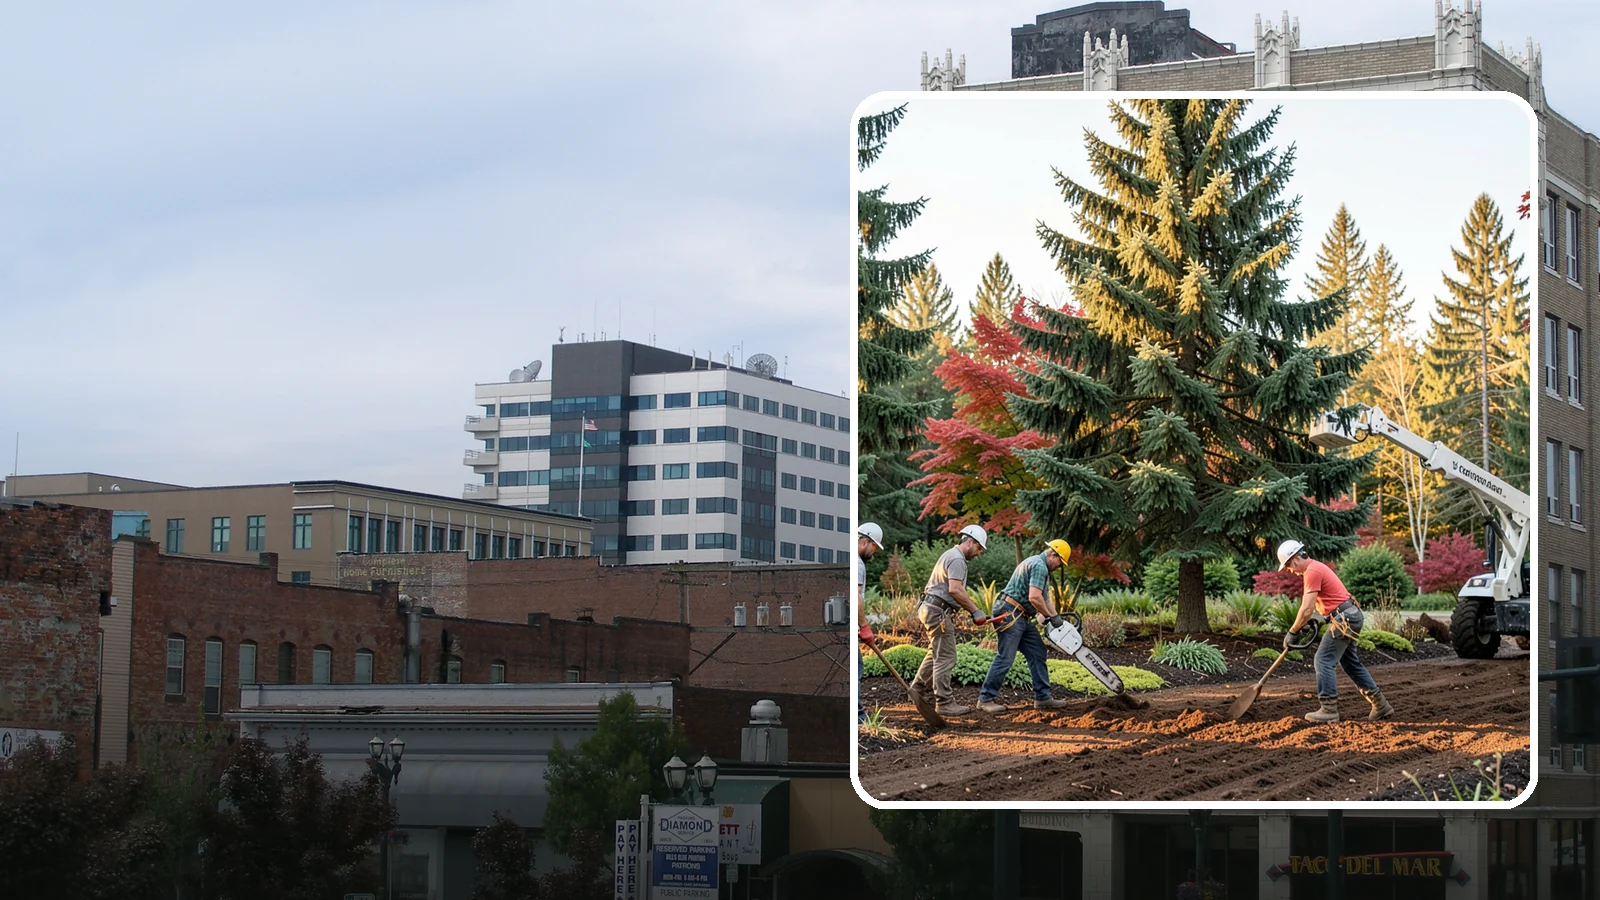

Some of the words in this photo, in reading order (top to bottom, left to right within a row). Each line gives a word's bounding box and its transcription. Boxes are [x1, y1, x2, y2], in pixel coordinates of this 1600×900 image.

[660, 818, 713, 833] DIAMOND
[1021, 815, 1070, 828] BUILDING
[617, 825, 625, 853] PAY
[628, 824, 637, 853] PAY
[656, 845, 688, 853] RESERVED
[689, 846, 716, 854] PARKING
[721, 852, 739, 863] Soup
[671, 862, 701, 870] PATRONS
[1289, 855, 1329, 874] TAC
[1345, 856, 1385, 875] DEL
[1392, 857, 1442, 876] MAR
[616, 856, 624, 894] HERE
[627, 856, 636, 894] HERE
[660, 888, 682, 897] PUBLIC
[683, 889, 711, 898] PARKING
